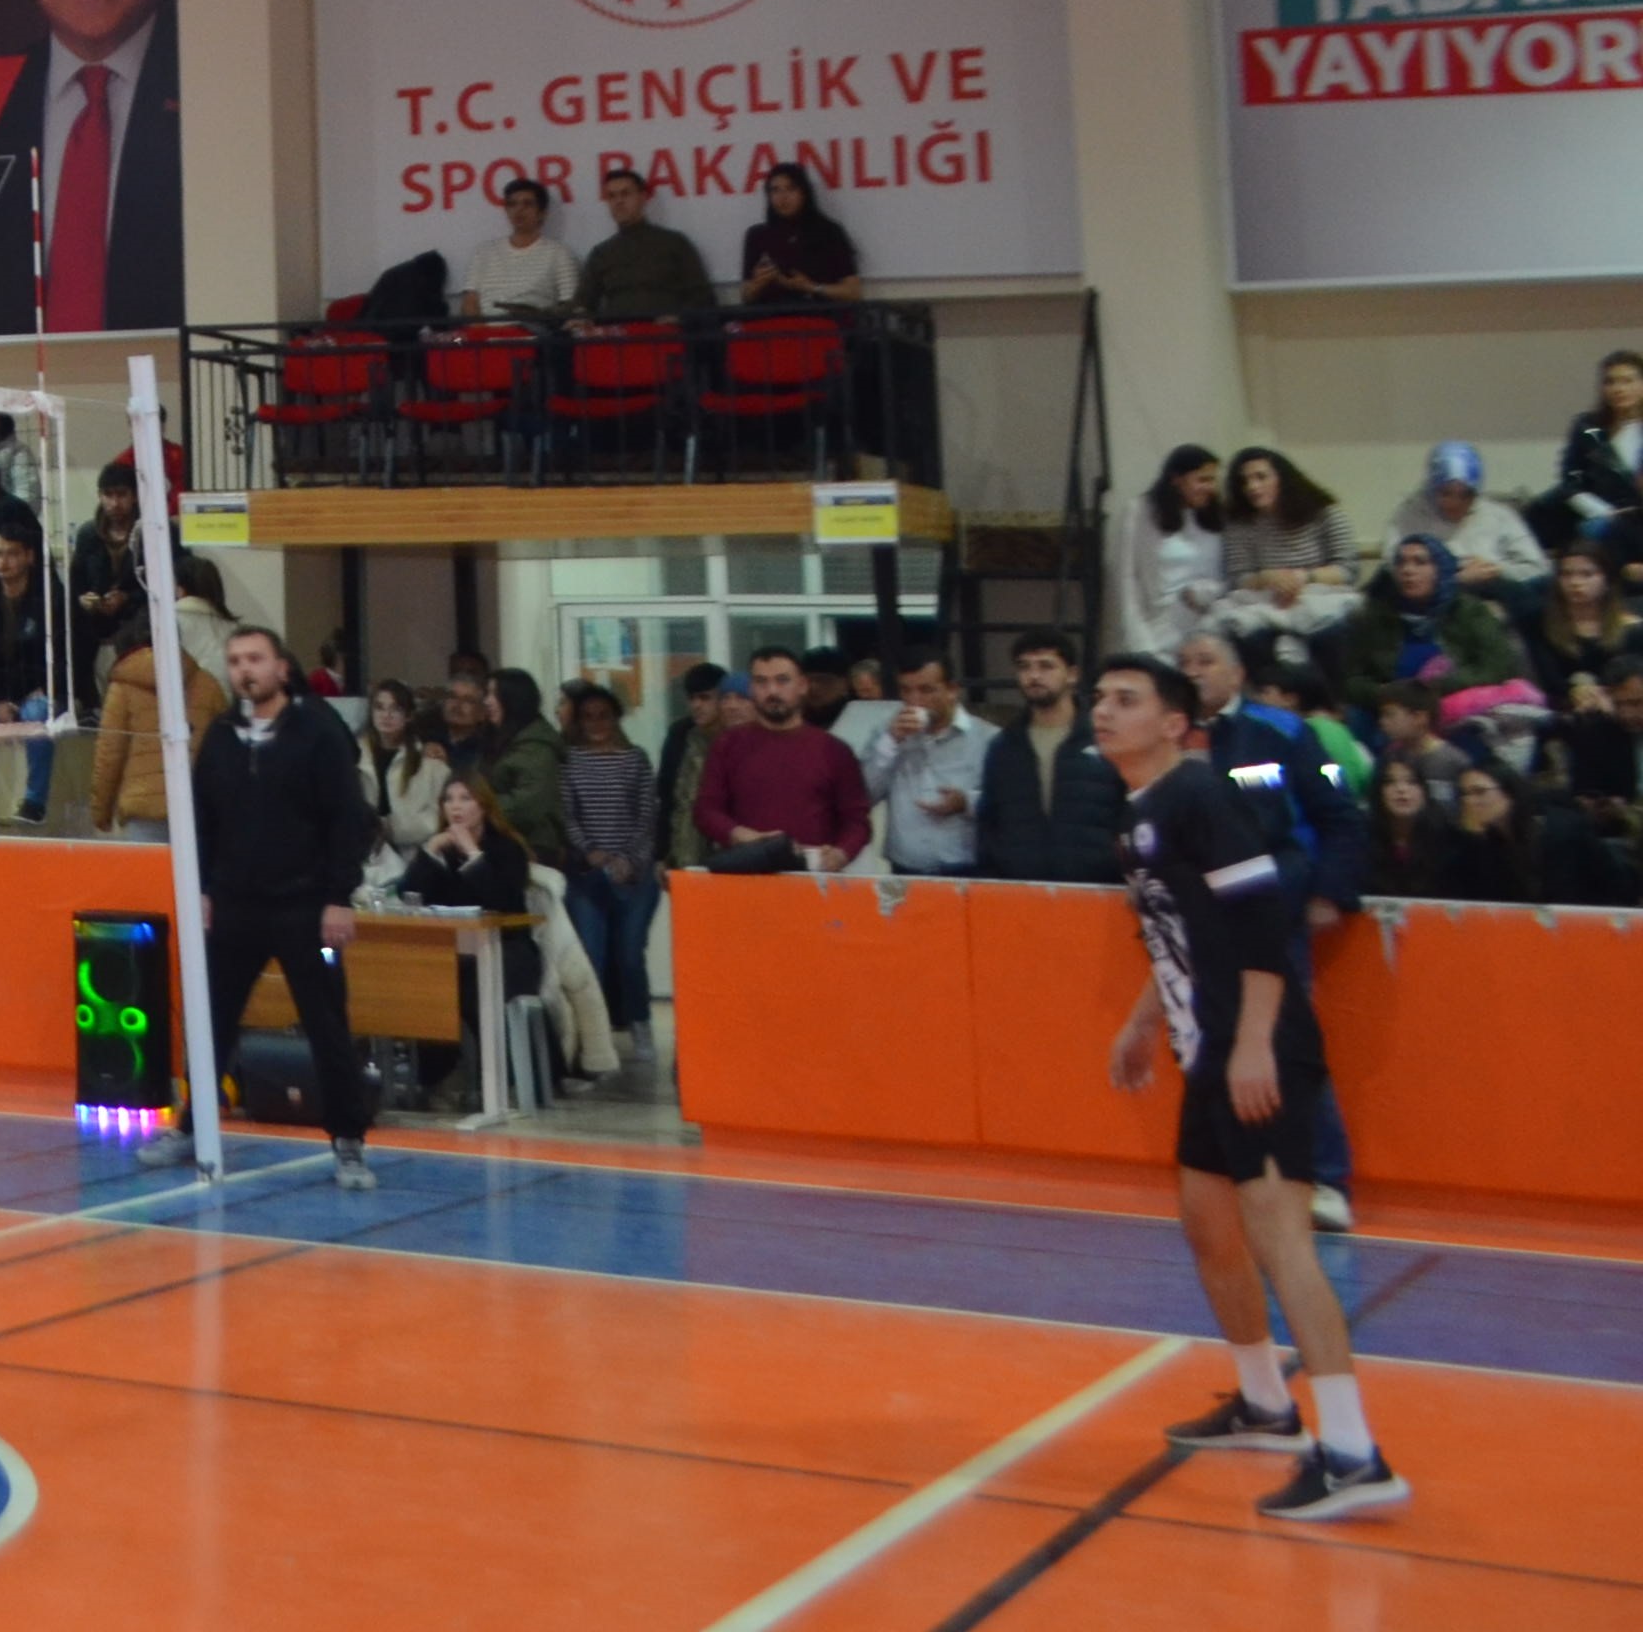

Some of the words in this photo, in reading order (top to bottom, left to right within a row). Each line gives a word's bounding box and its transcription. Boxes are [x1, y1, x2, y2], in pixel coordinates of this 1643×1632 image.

[396, 82, 516, 136] T.C.
[540, 47, 860, 131] GENÇLİK
[889, 47, 988, 103] VE
[1252, 20, 1643, 98] YAYIYOR
[402, 155, 574, 213] SPOR
